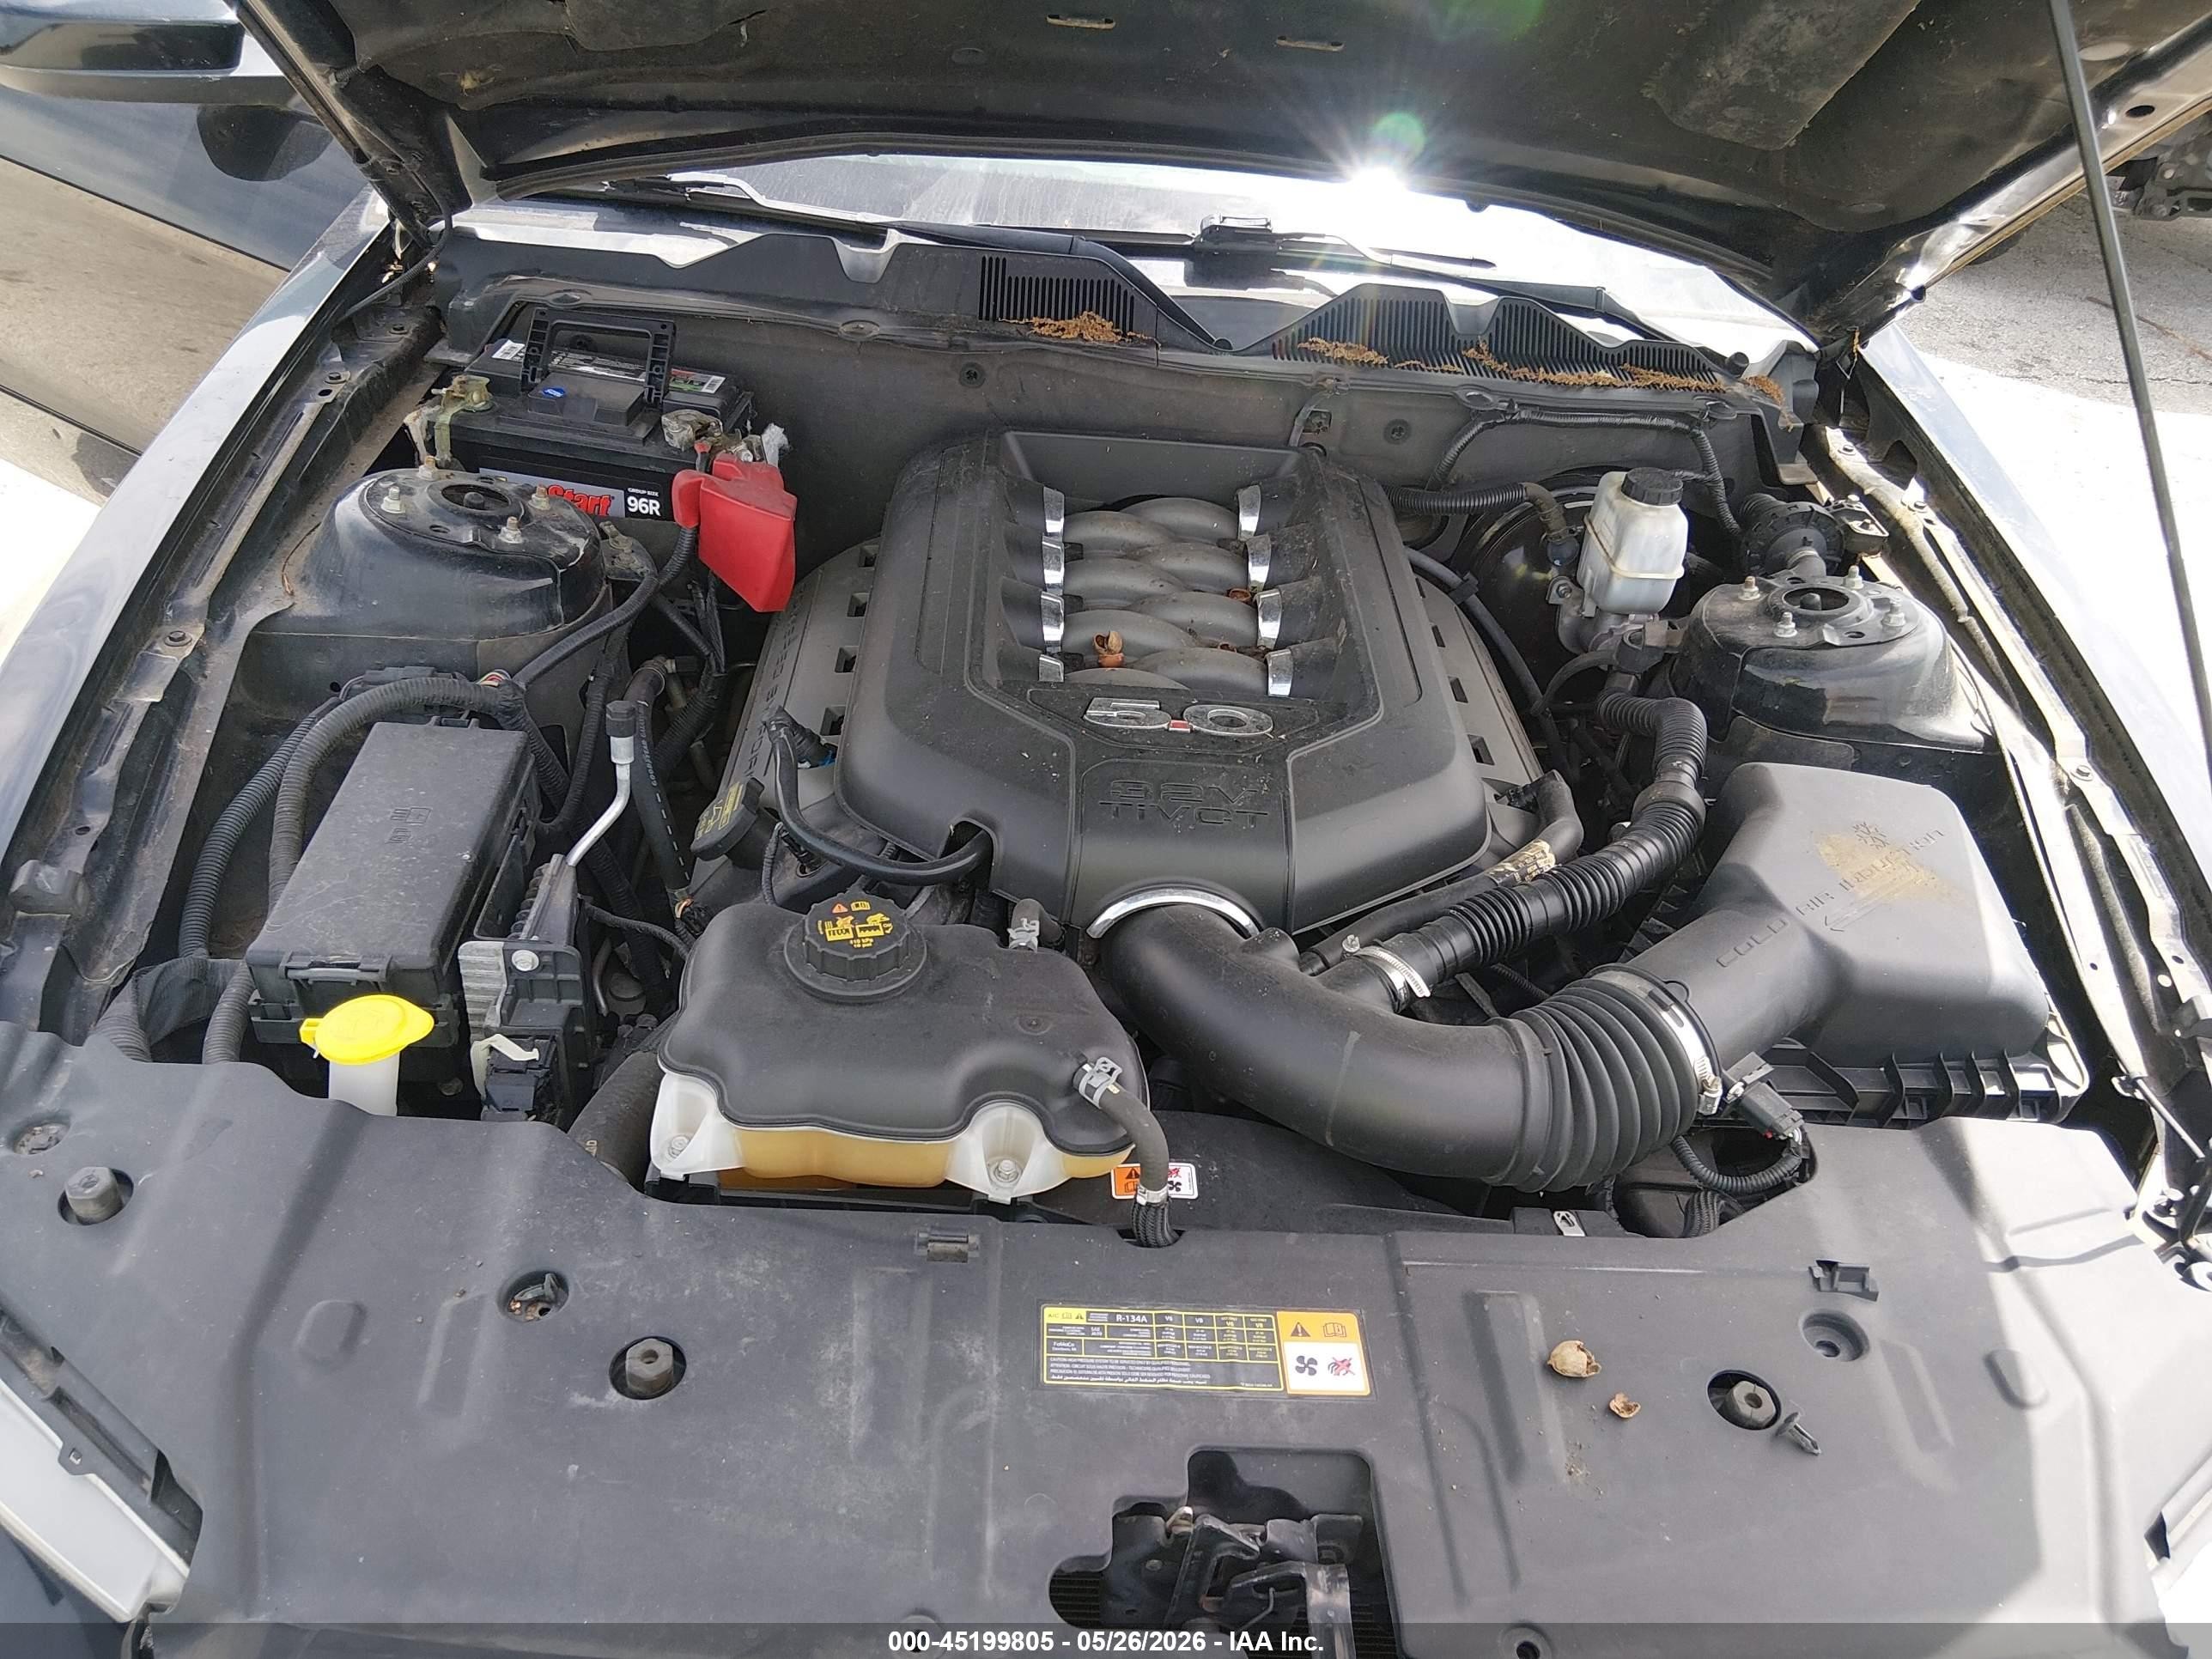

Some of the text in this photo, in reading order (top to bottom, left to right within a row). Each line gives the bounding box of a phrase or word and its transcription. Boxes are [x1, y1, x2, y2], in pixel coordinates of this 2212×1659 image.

[627, 495, 661, 517] 96R
[1083, 696, 1273, 736] 5.0
[1109, 780, 1260, 805] 32V
[1716, 916, 1790, 968] COLD
[1795, 890, 1836, 916] AIR
[1115, 1314, 1148, 1323] R-134A
